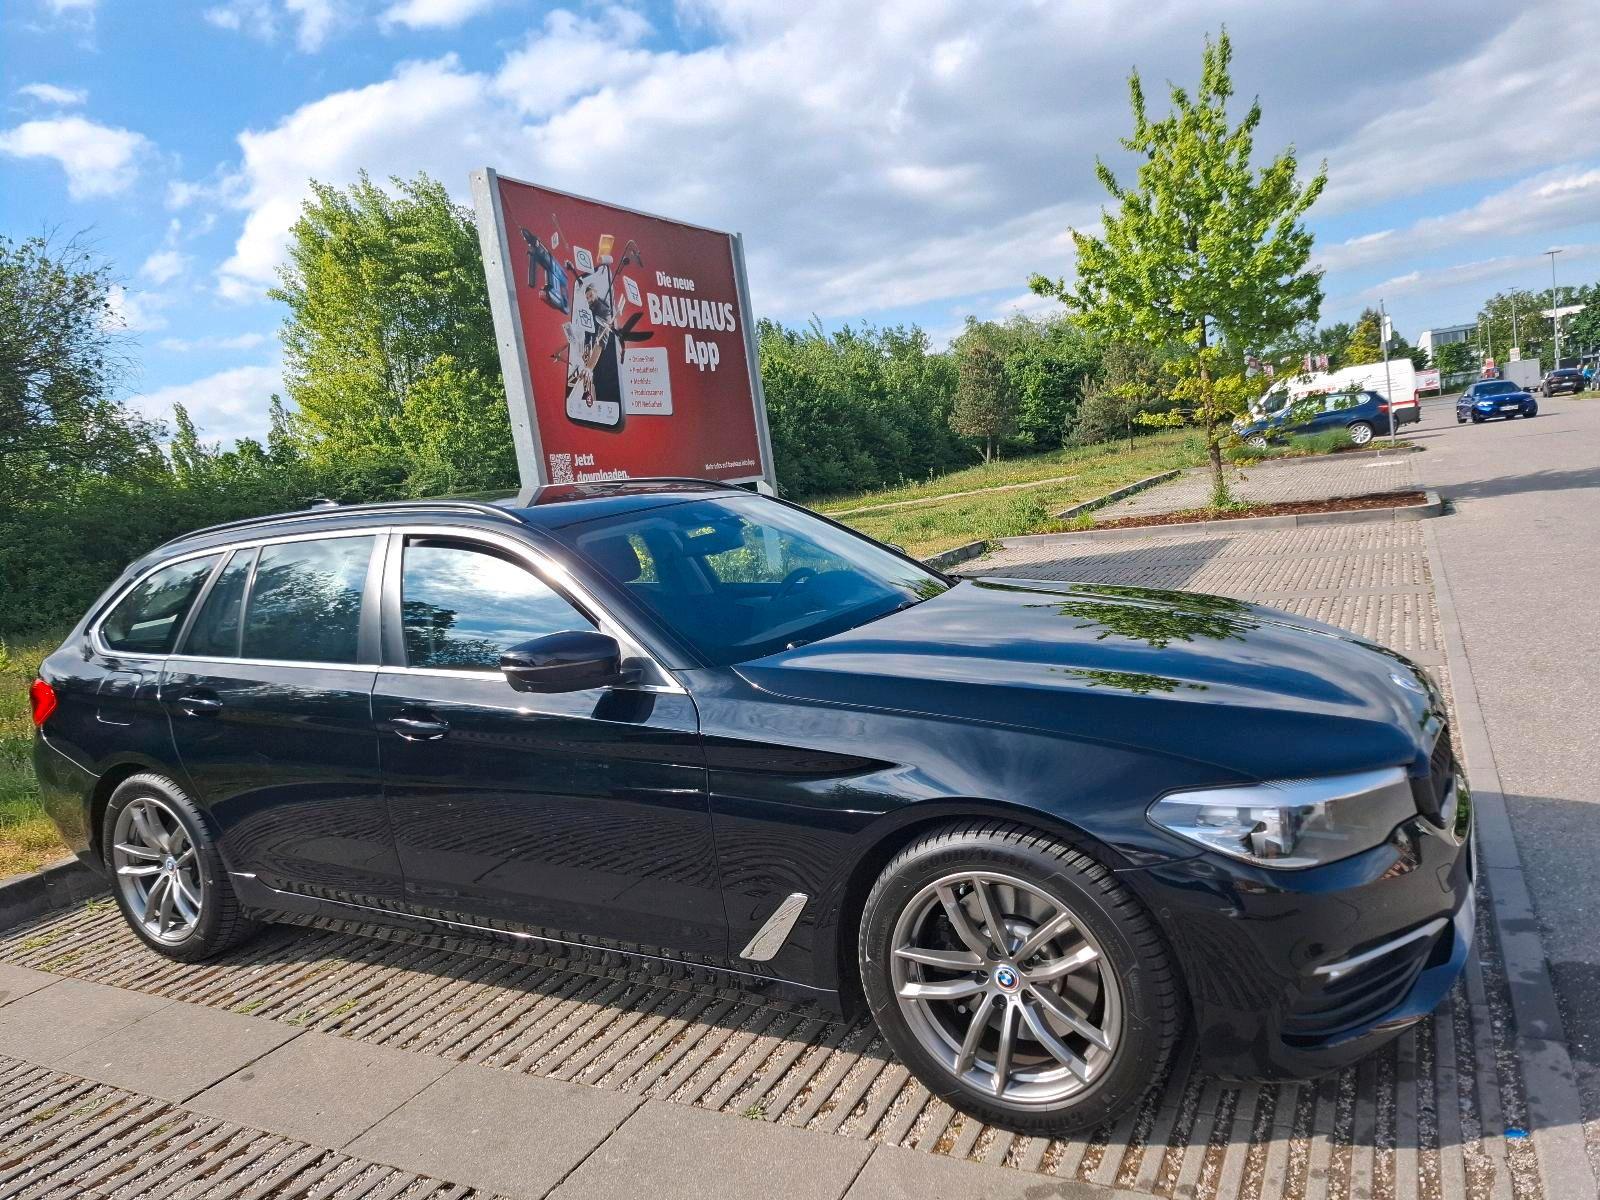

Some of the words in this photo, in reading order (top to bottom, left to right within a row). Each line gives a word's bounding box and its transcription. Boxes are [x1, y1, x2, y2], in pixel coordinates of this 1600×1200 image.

[656, 271, 672, 288] Die
[673, 277, 695, 291] neue
[647, 293, 736, 332] BAUHAUS
[685, 334, 720, 371] App
[575, 453, 595, 466] Jetzt
